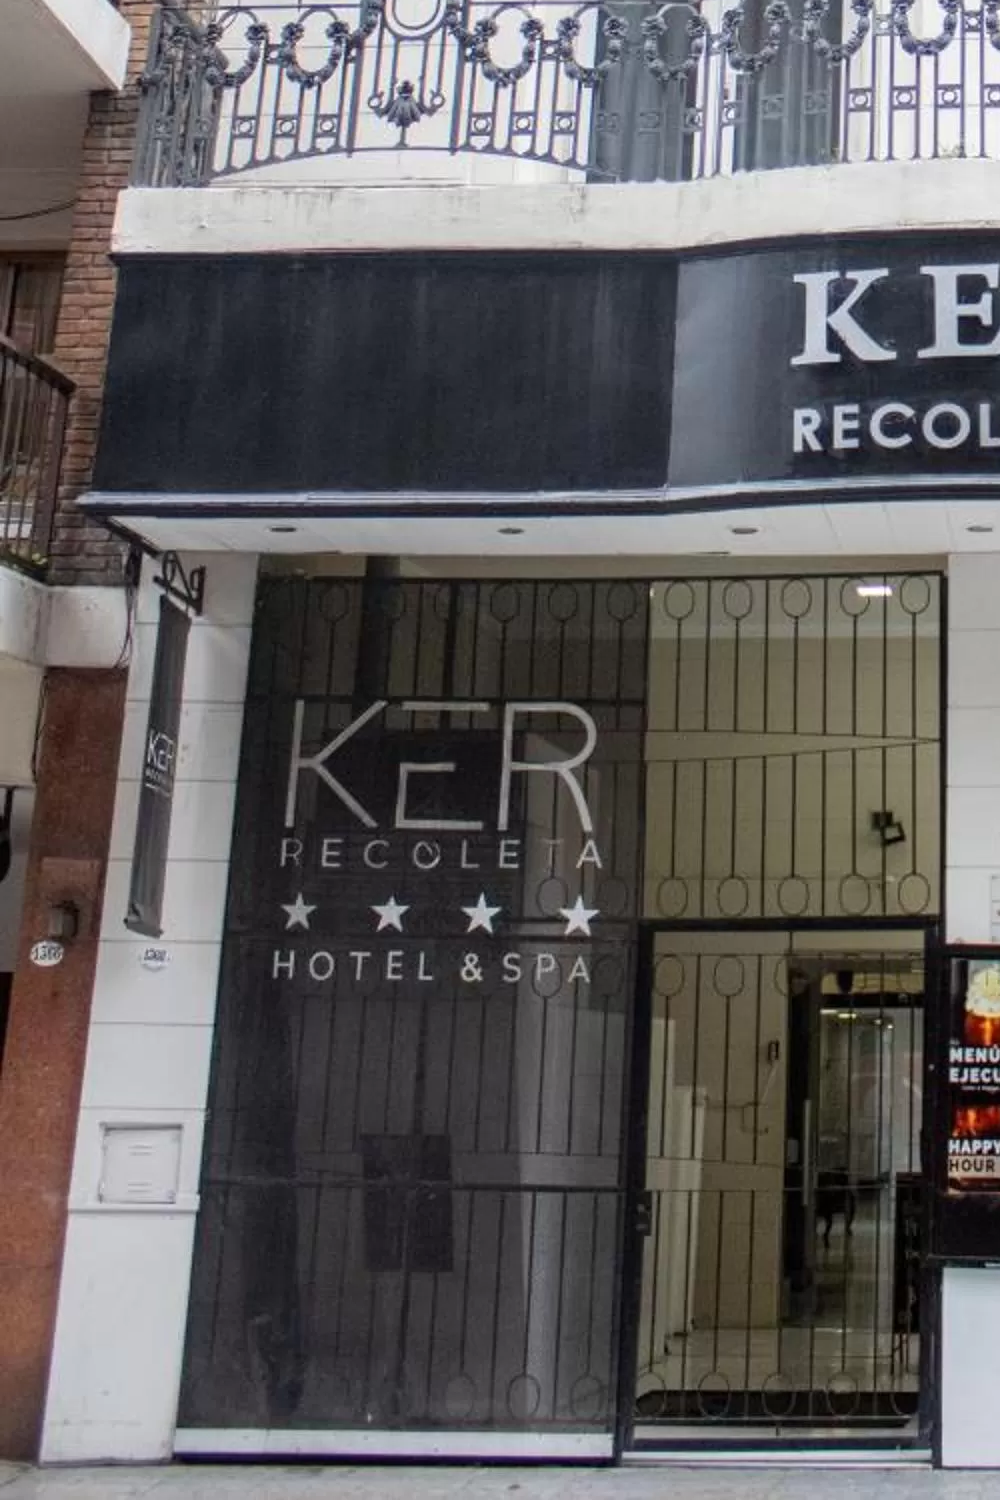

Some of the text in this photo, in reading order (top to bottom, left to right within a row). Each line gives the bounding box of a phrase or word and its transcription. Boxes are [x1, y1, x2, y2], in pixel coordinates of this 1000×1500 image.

[285, 699, 598, 833] KER
[279, 838, 603, 870] RECOLETA
[272, 951, 592, 985] HOTEL & SPA
[949, 1158, 996, 1173] HOUR
